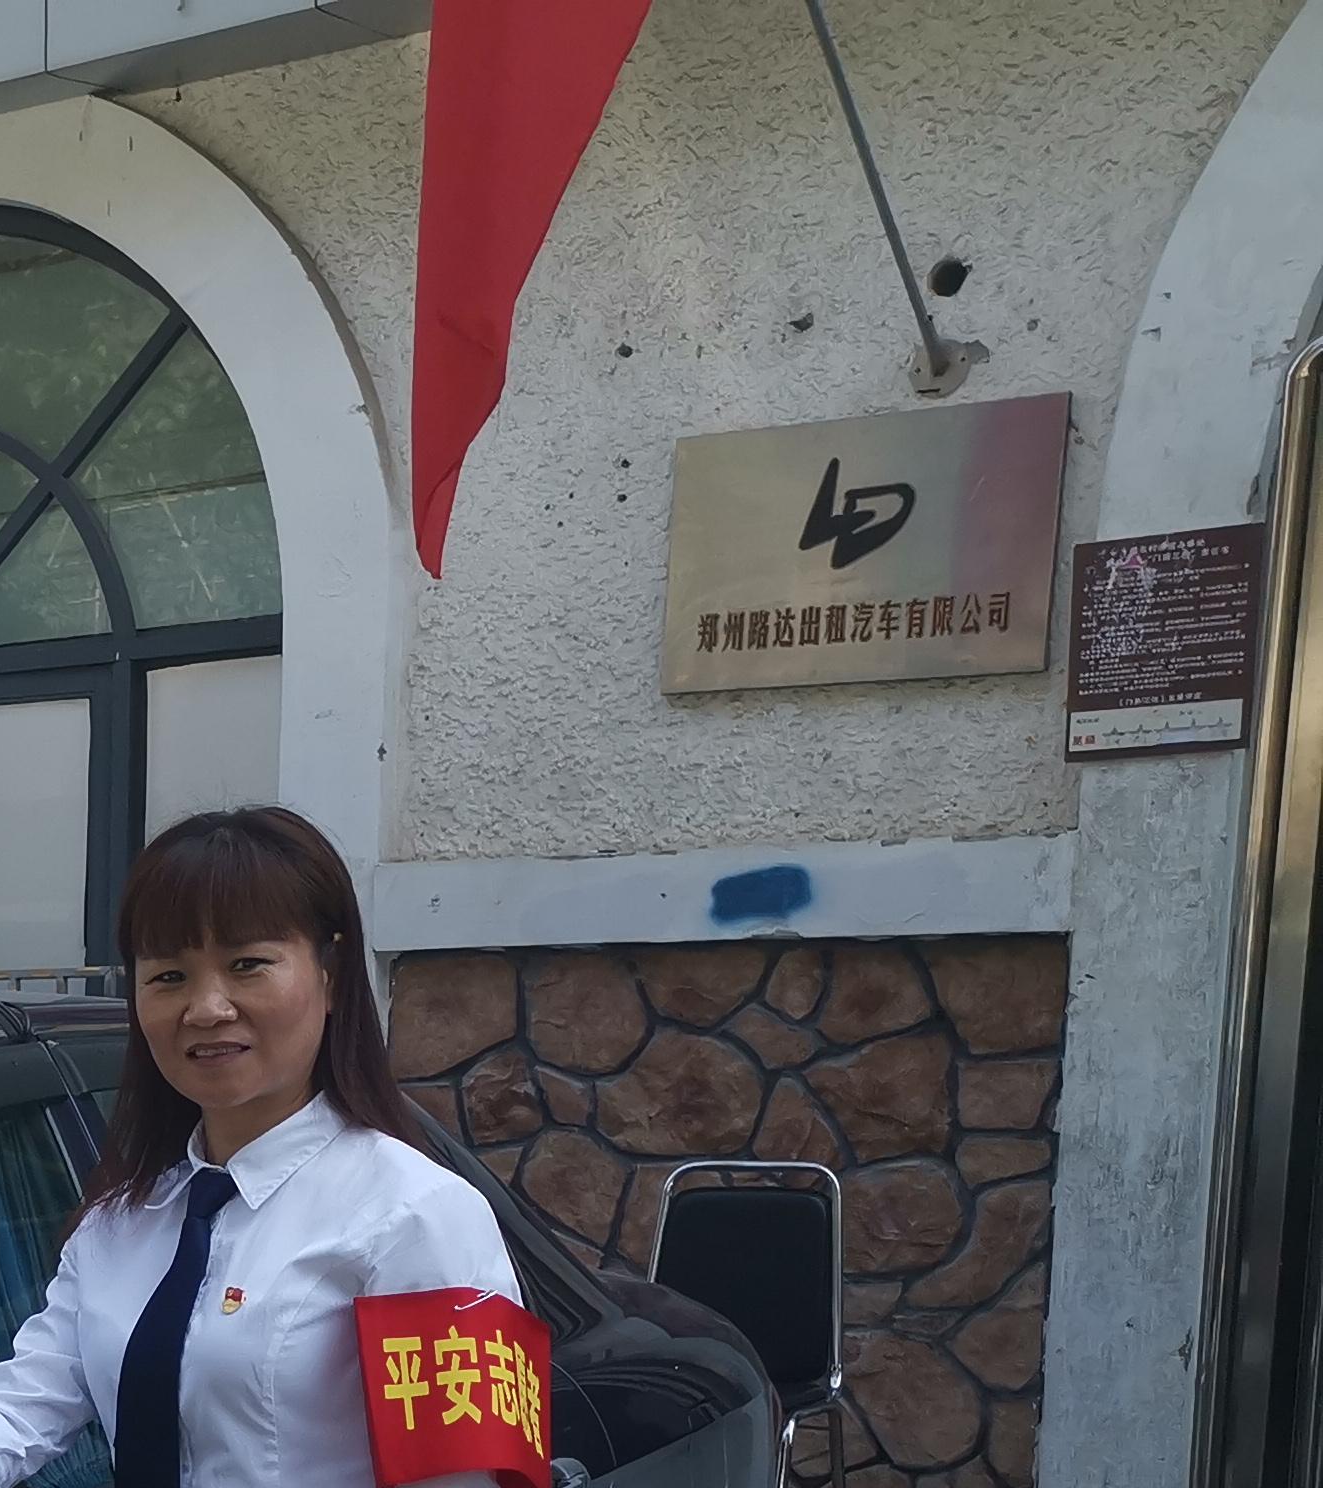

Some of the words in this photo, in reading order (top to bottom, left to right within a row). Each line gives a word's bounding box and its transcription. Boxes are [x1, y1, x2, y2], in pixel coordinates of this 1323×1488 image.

[696, 591, 1011, 654] 郑州路达出租汽车有限公司
[382, 1324, 545, 1460] 平安志愿者
